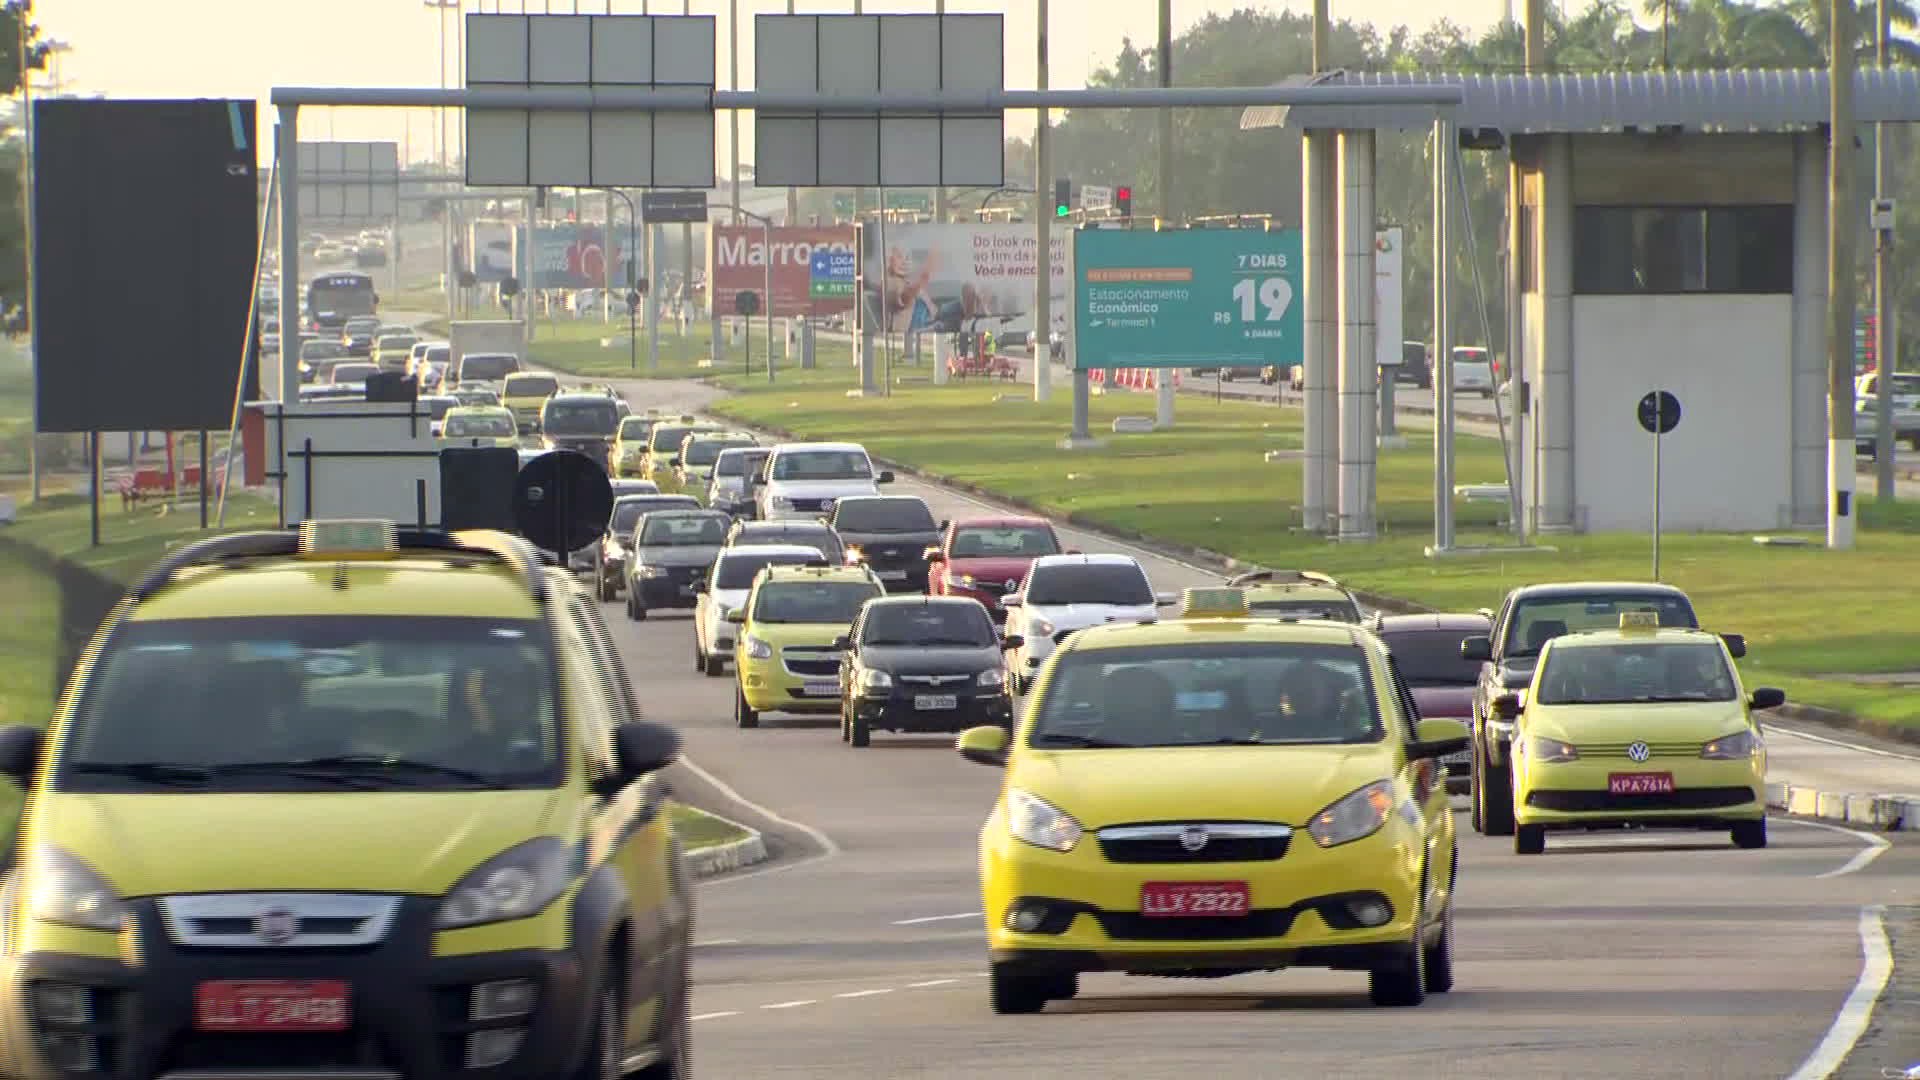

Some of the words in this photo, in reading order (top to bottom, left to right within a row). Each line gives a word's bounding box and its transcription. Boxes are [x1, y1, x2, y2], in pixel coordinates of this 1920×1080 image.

[992, 232, 1018, 247] look
[830, 255, 854, 265] LOCA
[1238, 255, 1247, 268] 7
[1250, 254, 1287, 268] DIAS
[1089, 287, 1189, 301] Estacionamento
[1213, 311, 1231, 324] R$
[1232, 278, 1293, 322] 19
